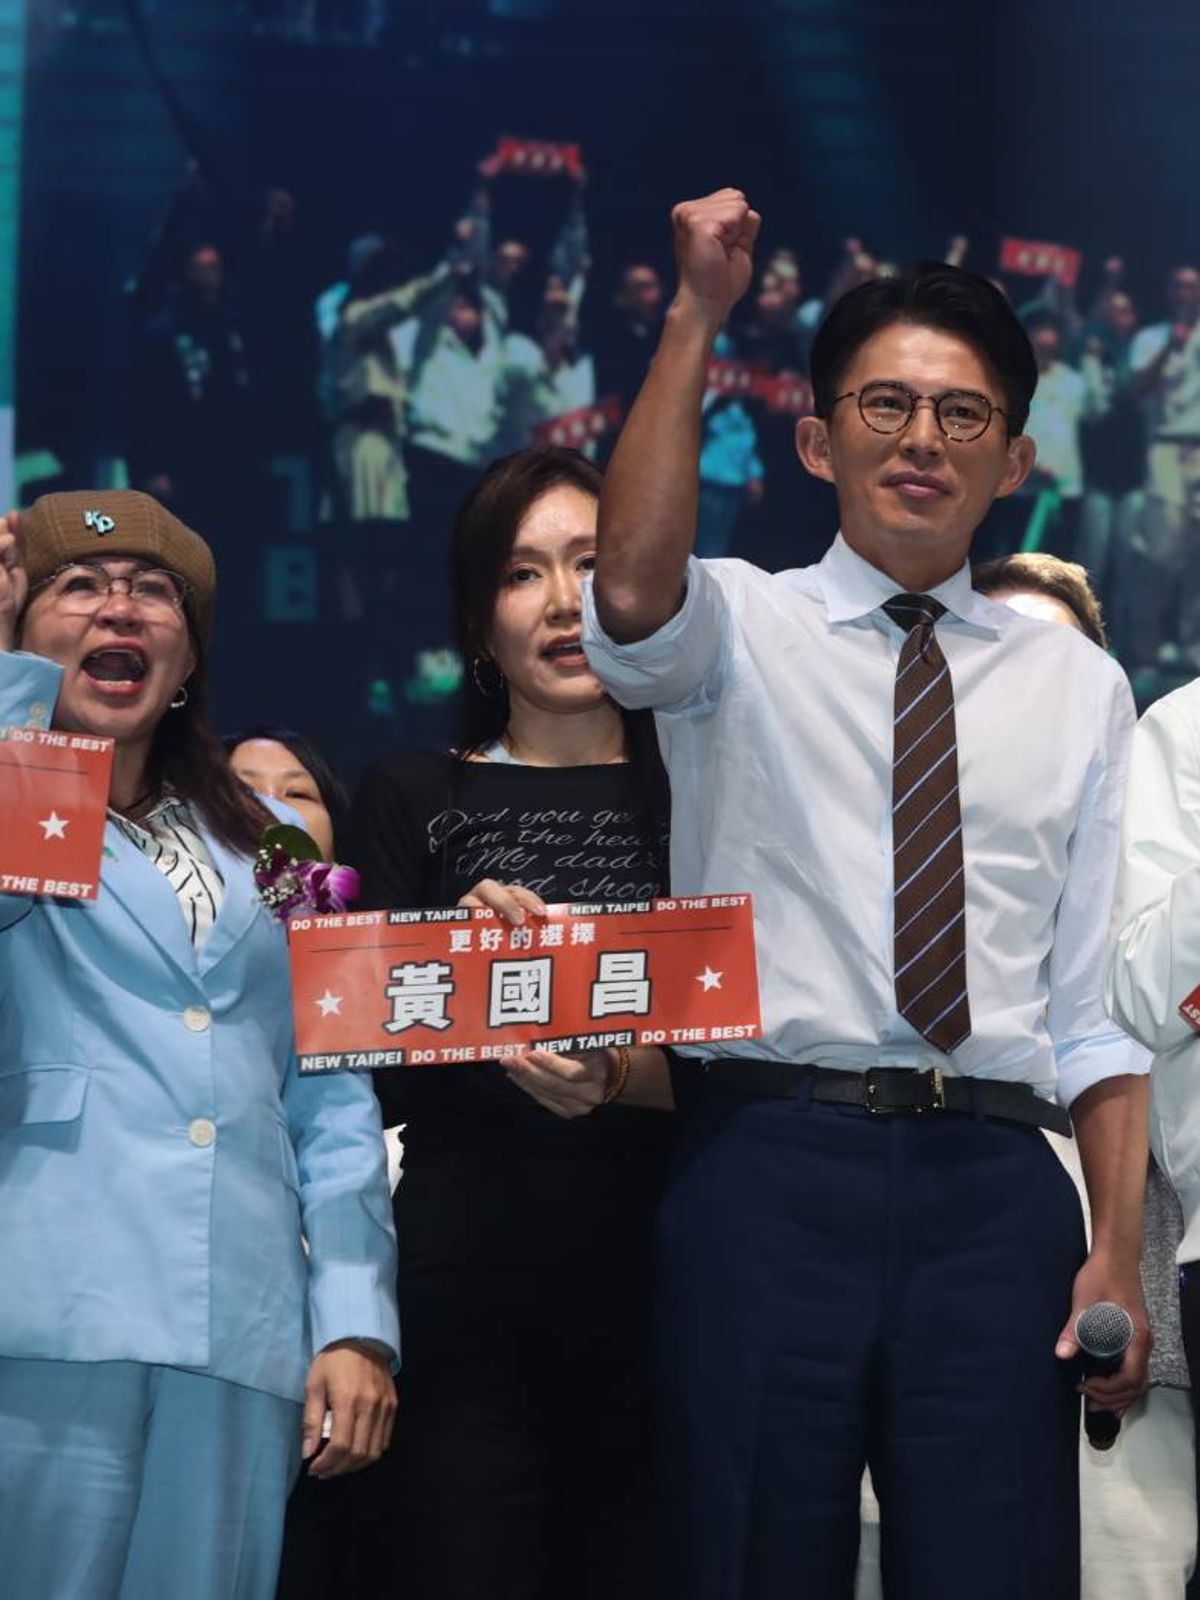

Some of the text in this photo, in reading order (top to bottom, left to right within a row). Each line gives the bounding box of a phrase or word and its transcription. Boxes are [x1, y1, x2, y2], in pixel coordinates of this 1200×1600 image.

[12, 730, 34, 742] DO
[38, 732, 67, 748] THE
[70, 737, 110, 753] BEST
[518, 809, 583, 828] you
[517, 830, 575, 846] the
[1, 875, 93, 898] THE BEST
[291, 896, 747, 931] DO THE BEST NEW TAIPEI DO NEW TAIPEI DO THE BEST
[448, 922, 596, 953] 更好的選擇
[385, 951, 650, 1033] 黃國昌
[301, 1024, 757, 1070] NEW TAIPEI DO THE BEST NEW TAIPEI DO THE BEST
